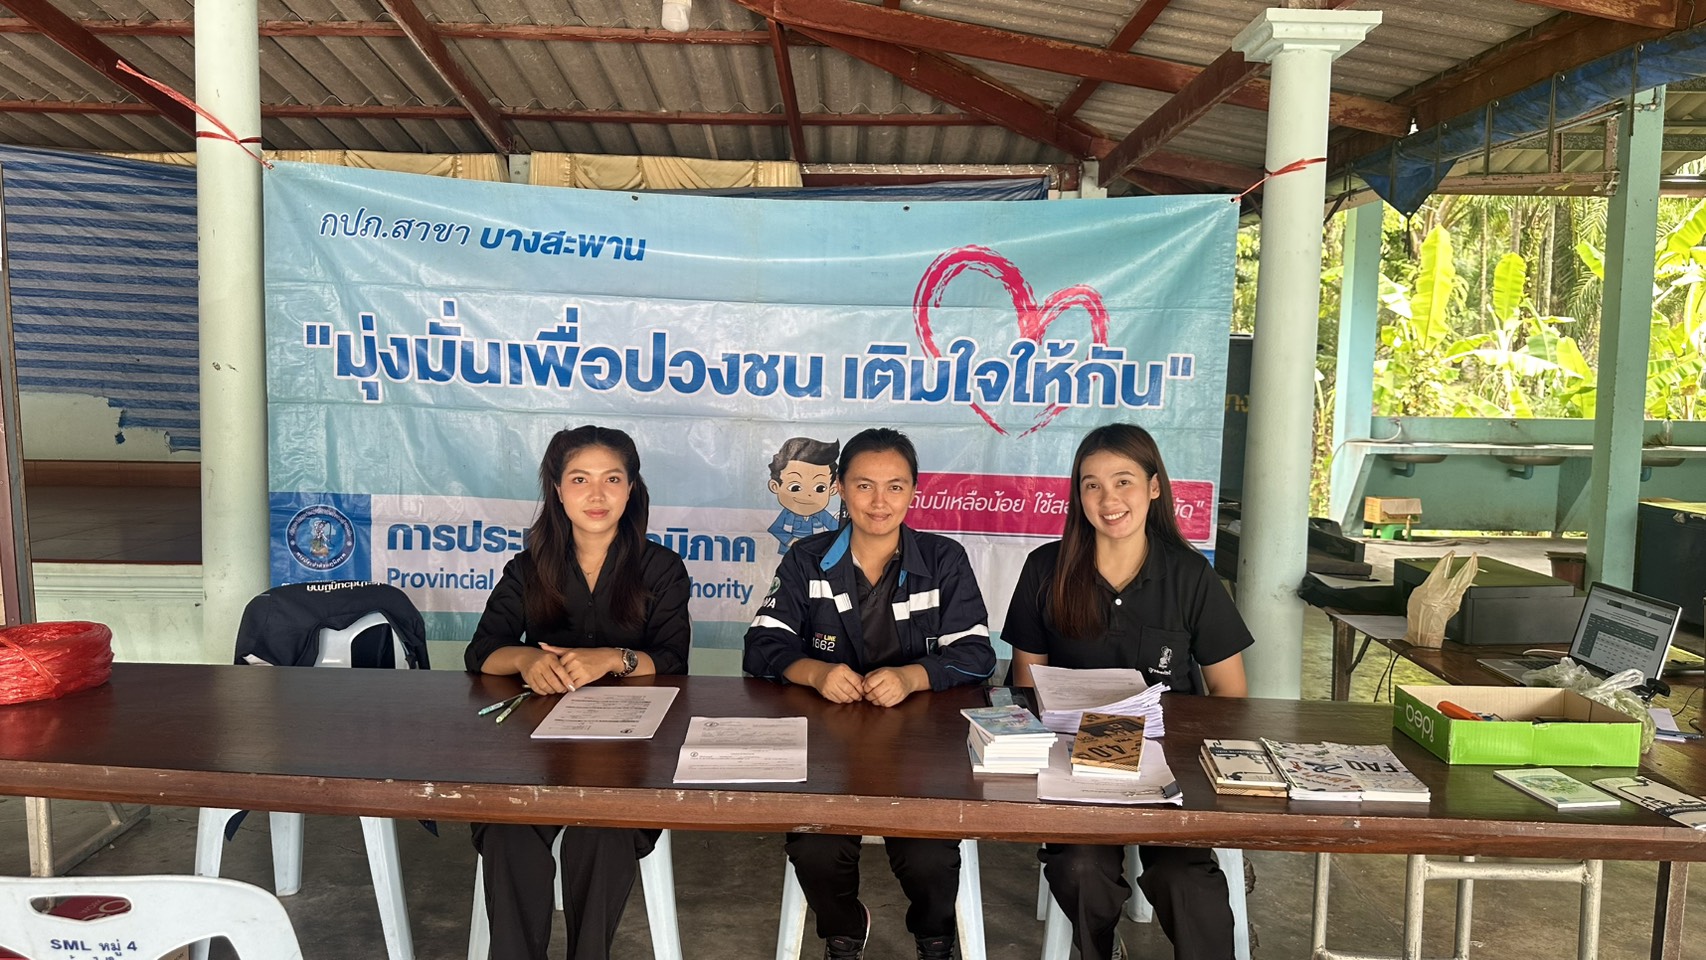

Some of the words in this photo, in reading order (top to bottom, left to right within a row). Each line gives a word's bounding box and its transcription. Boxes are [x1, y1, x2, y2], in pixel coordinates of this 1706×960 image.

[319, 206, 472, 246] กปภ.สาขา
[480, 225, 647, 262] บางสะพาน
[304, 299, 825, 403] "มุ่งมั่นเพื่อปวงชน
[842, 336, 1195, 410] เติมใจให้กัน"
[387, 568, 494, 590] Provincial
[690, 576, 754, 605] hority
[812, 636, 836, 652] 1662
[823, 634, 837, 643] LINE
[1405, 703, 1434, 743] idea
[1343, 758, 1400, 774] FAQ
[50, 939, 92, 951] SML
[127, 941, 138, 952] 4
